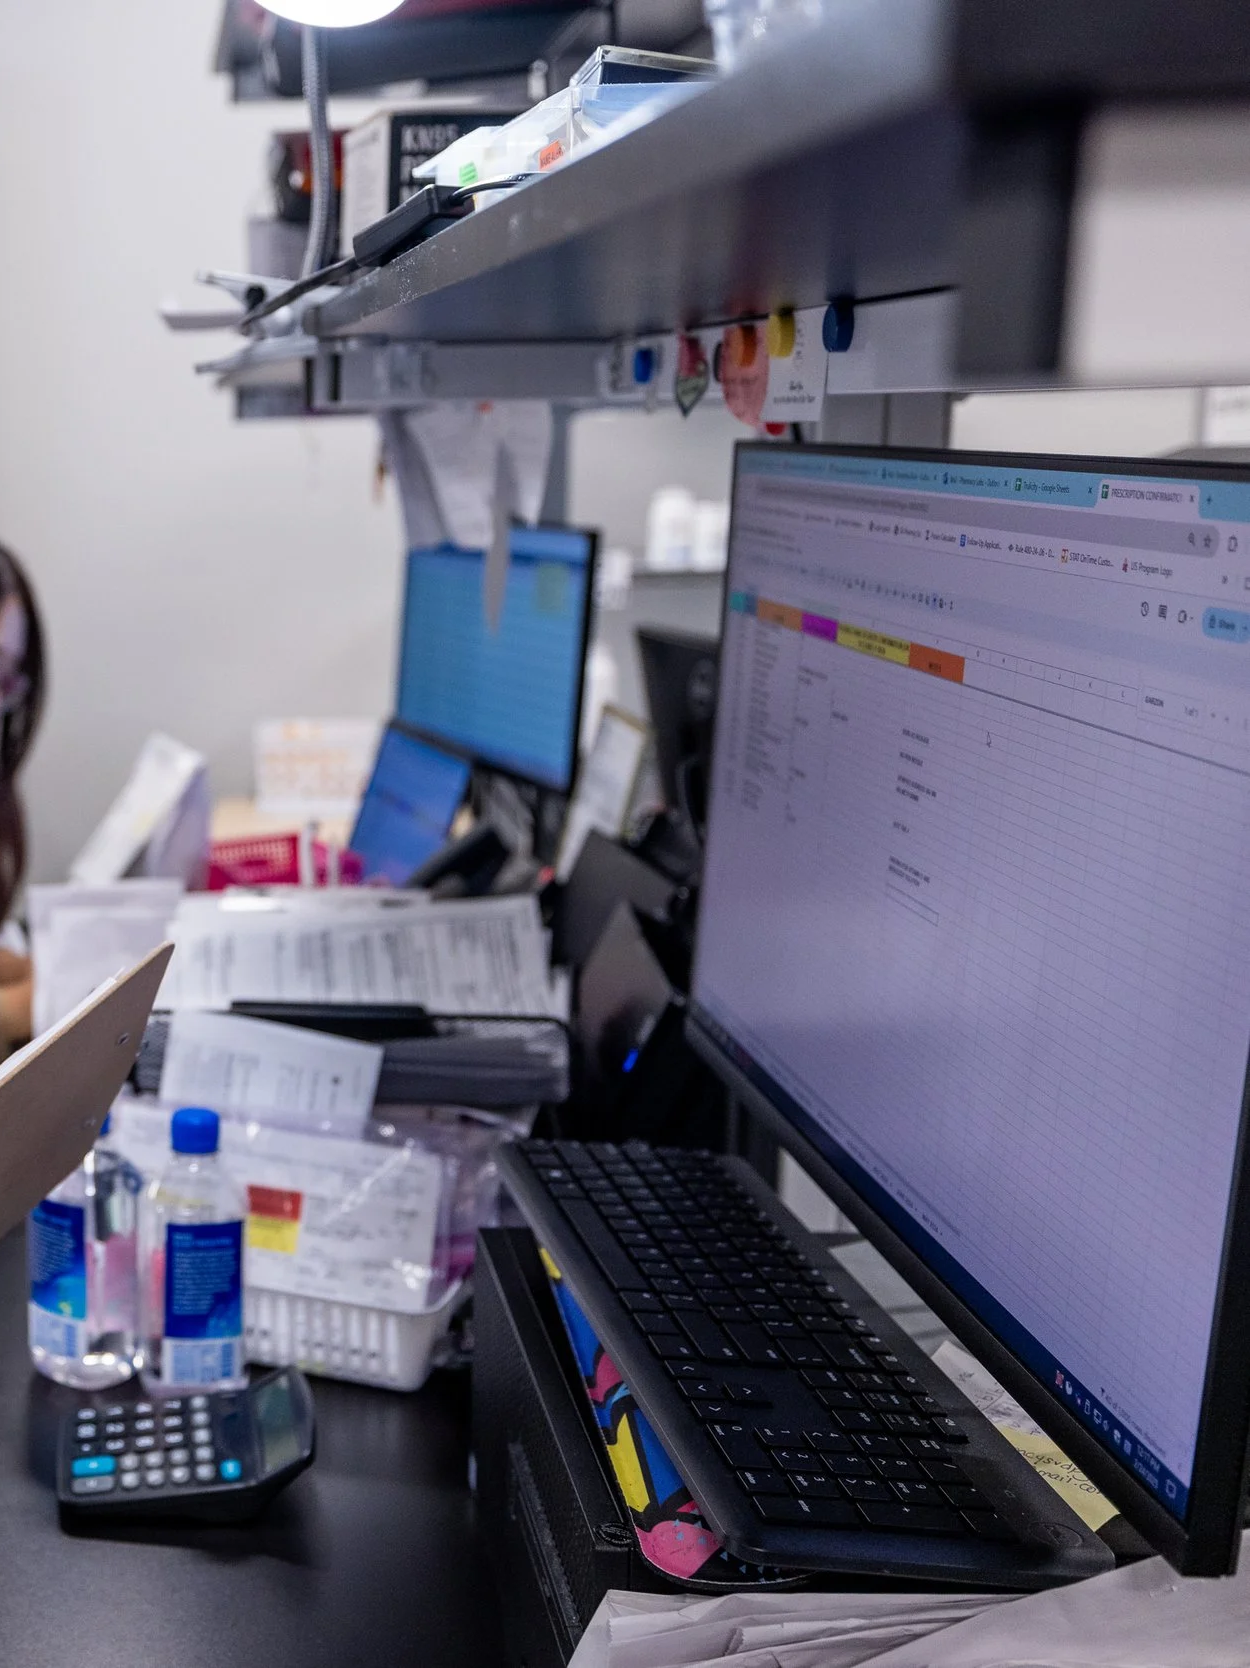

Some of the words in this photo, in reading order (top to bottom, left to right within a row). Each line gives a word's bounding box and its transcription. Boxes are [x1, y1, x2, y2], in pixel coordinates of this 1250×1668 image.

[1041, 482, 1055, 494] Google
[1056, 483, 1070, 493] Sheets
[1111, 488, 1145, 500] PRESCRIPTION
[1080, 554, 1097, 565] OnTime
[1139, 562, 1159, 575] Program
